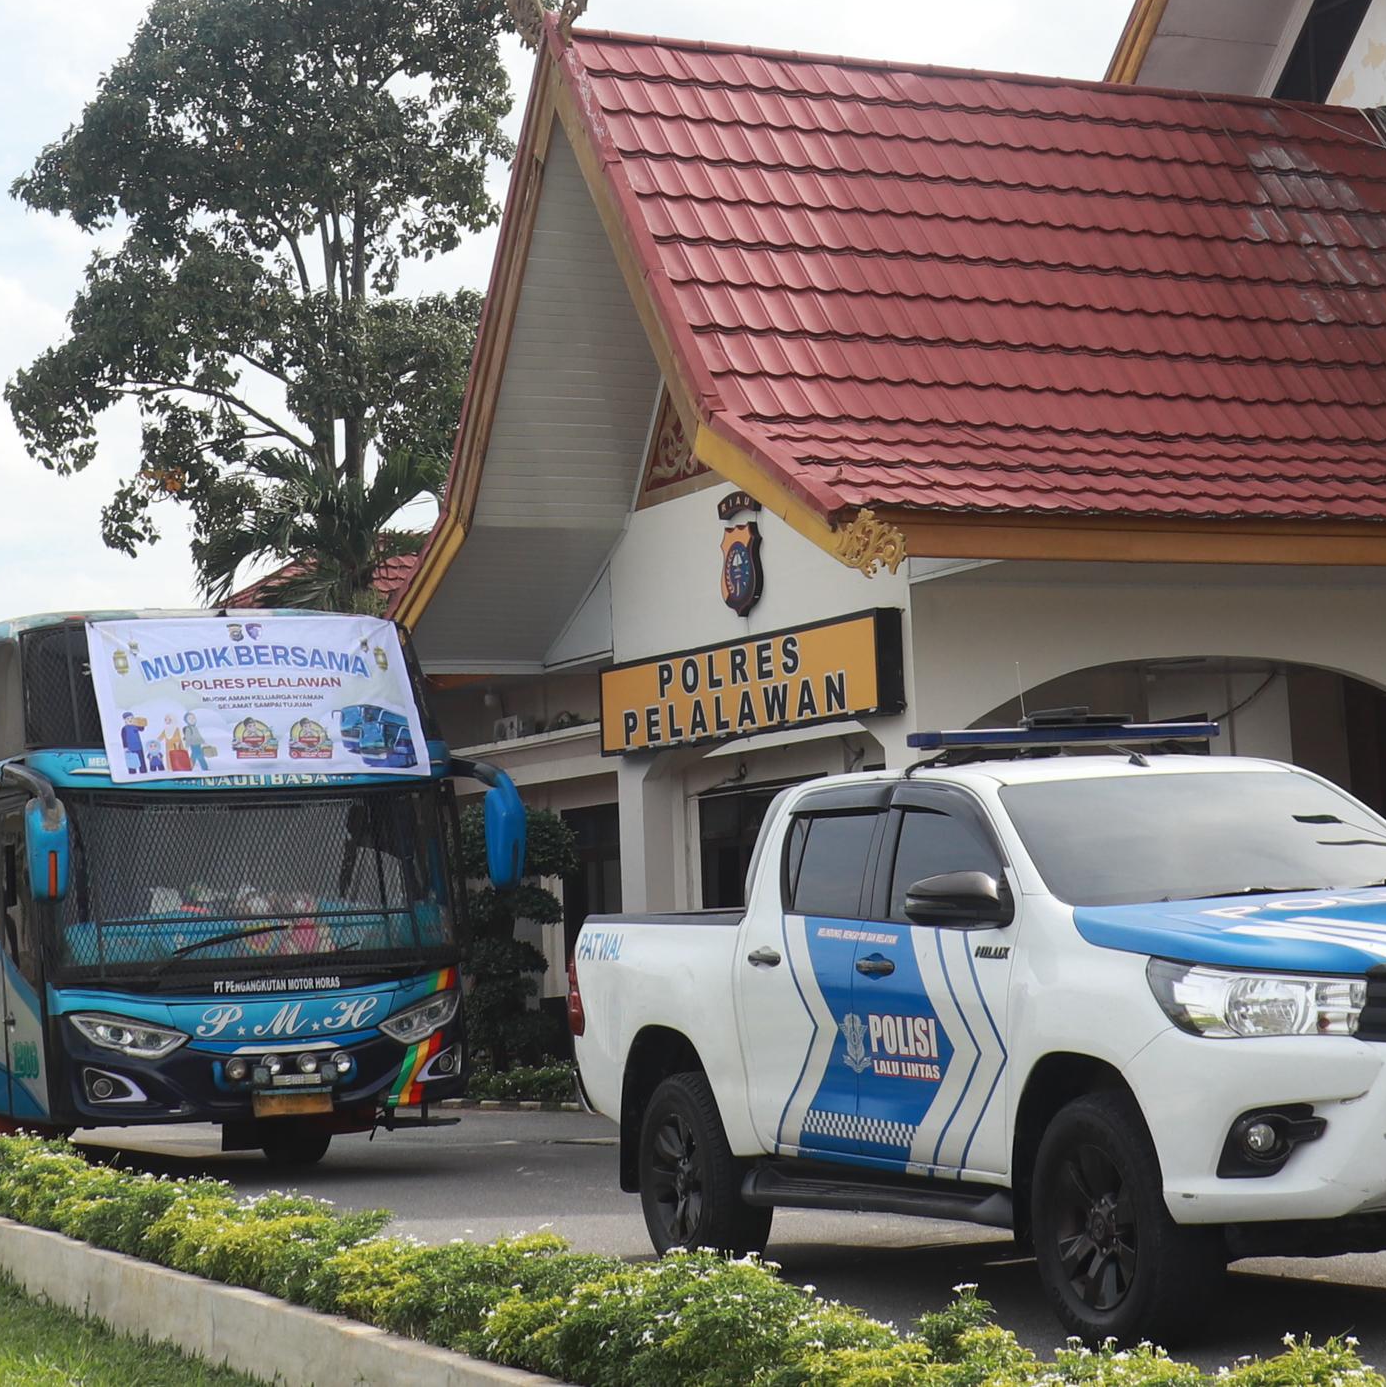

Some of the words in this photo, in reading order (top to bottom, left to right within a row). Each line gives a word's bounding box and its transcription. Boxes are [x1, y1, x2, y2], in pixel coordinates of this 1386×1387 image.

[721, 496, 750, 512] RIAU
[141, 645, 232, 681] MUDIK
[234, 645, 370, 678] BERSAMA
[658, 636, 799, 699] POLRES
[181, 678, 244, 691] POLRES
[247, 677, 342, 689] PELALAWAN
[218, 702, 252, 710] SELAMAT
[623, 671, 847, 746] PELALAWAN
[272, 773, 330, 785] BASA
[577, 933, 624, 960] PATWAL
[974, 945, 1011, 960] HILUX
[214, 981, 224, 993] PT
[288, 978, 314, 990] MOTOR
[315, 976, 341, 989] HORAS
[868, 1014, 939, 1058] POLISI
[873, 1059, 900, 1076] LALU
[901, 1062, 941, 1080] LINTAS
